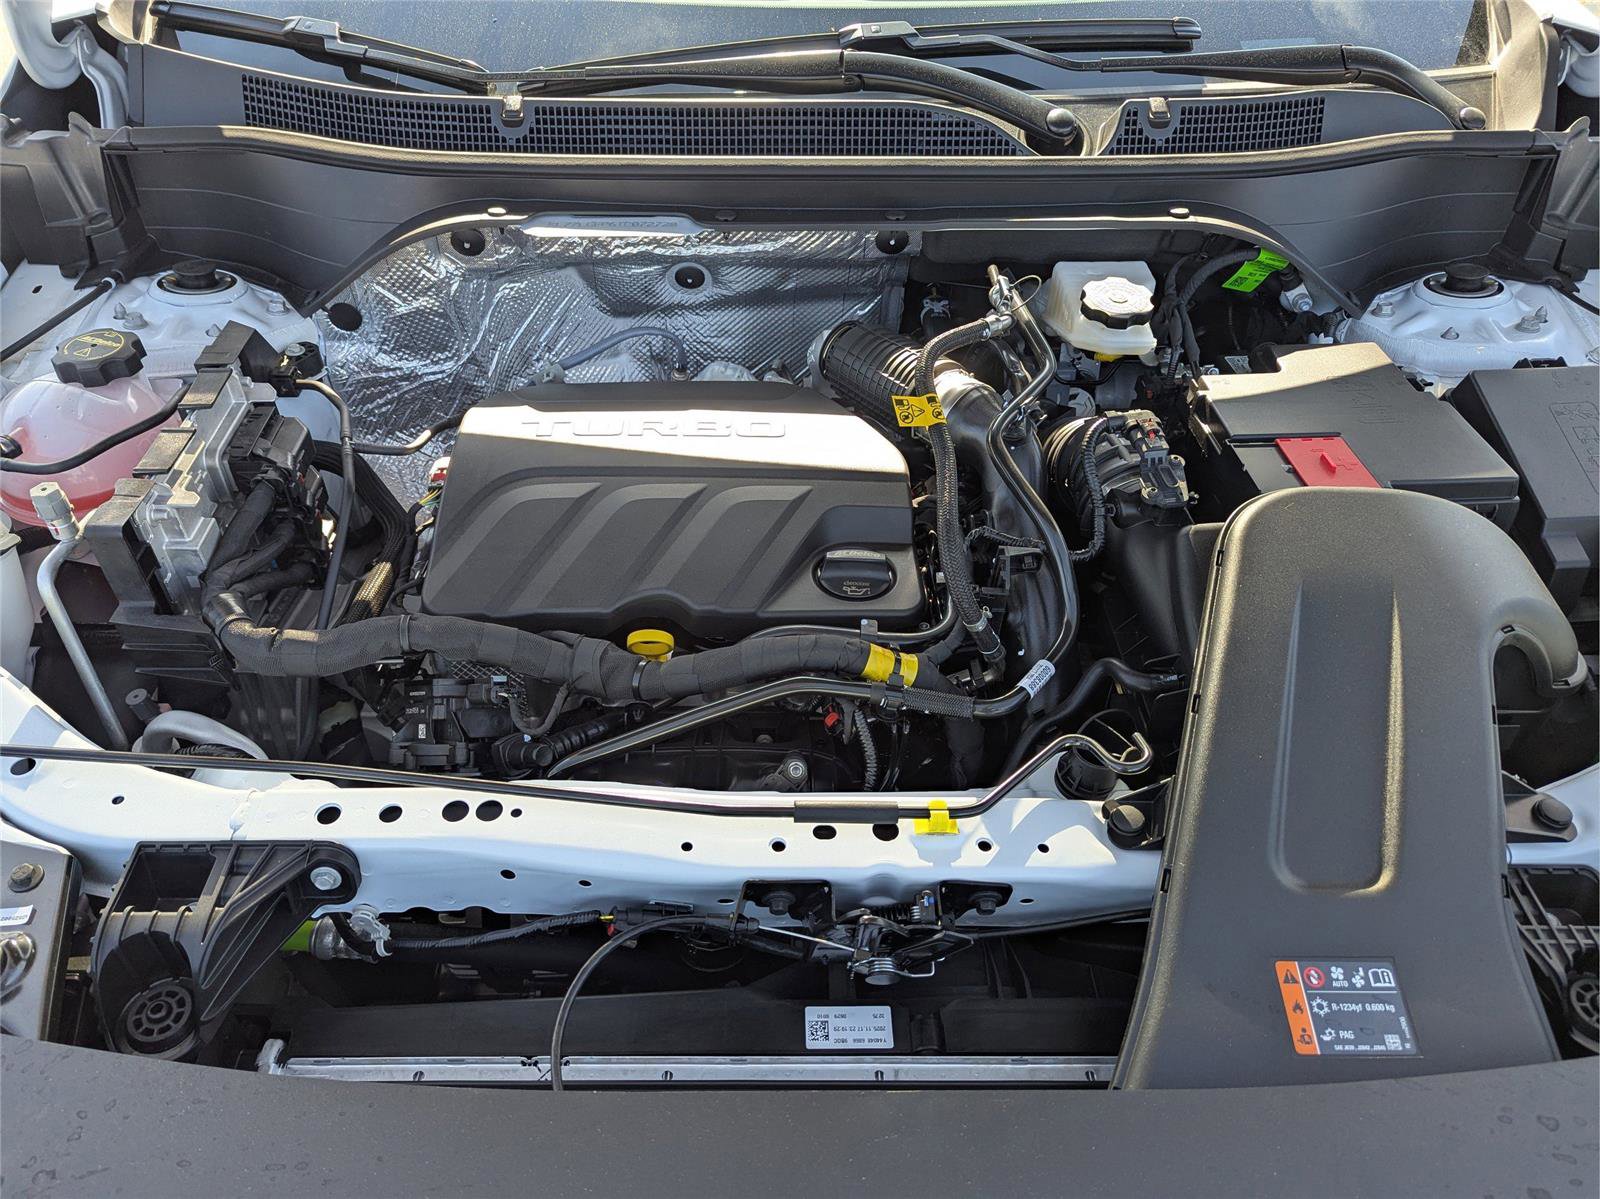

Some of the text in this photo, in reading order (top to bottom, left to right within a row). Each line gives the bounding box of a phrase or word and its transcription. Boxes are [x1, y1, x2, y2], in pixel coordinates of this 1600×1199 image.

[520, 418, 786, 438] TURBO
[1332, 980, 1349, 988] AUTO
[1365, 1003, 1385, 1012] 0.600
[1385, 1003, 1396, 1013] kg
[1338, 1030, 1356, 1040] PAG
